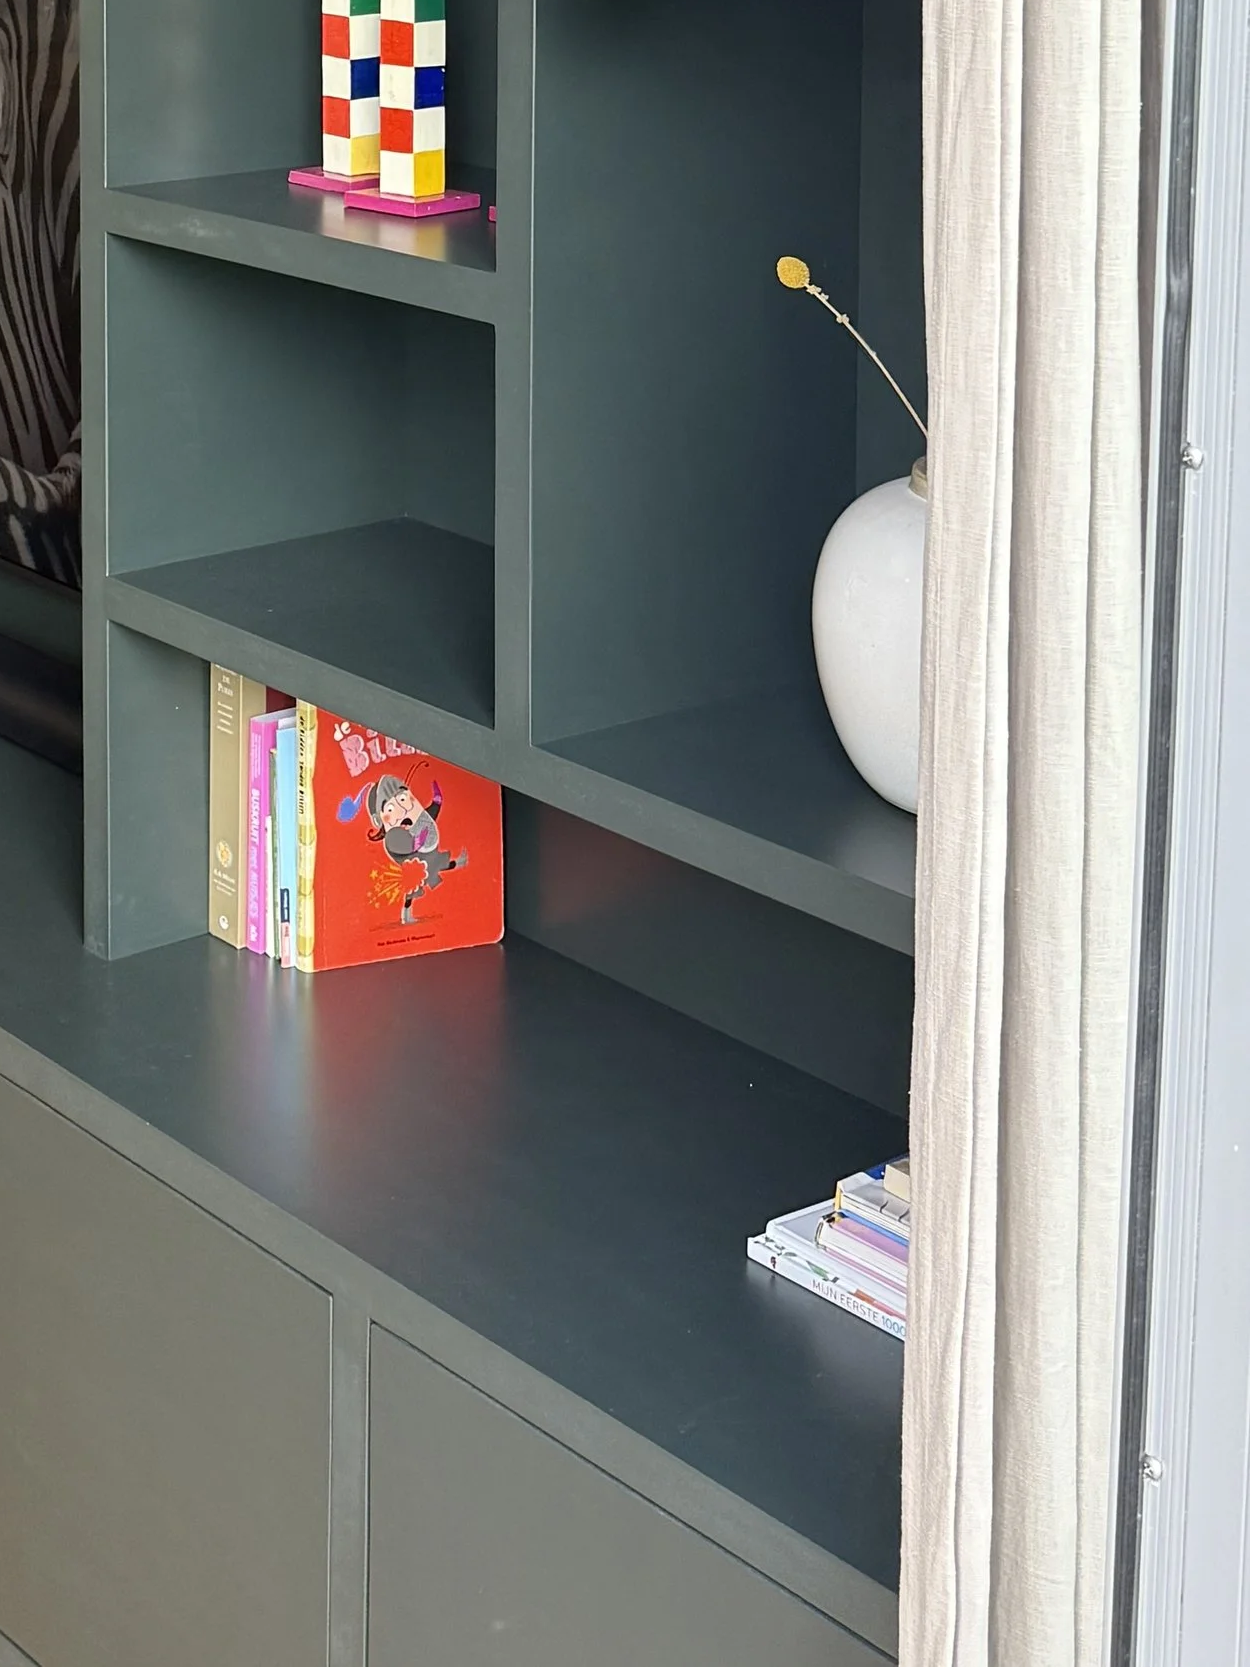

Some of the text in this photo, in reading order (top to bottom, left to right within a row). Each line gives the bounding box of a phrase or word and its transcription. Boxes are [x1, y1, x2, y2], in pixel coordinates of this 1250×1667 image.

[333, 721, 352, 742] de
[812, 1278, 838, 1301] MIJN
[839, 1294, 879, 1324] EERSTE
